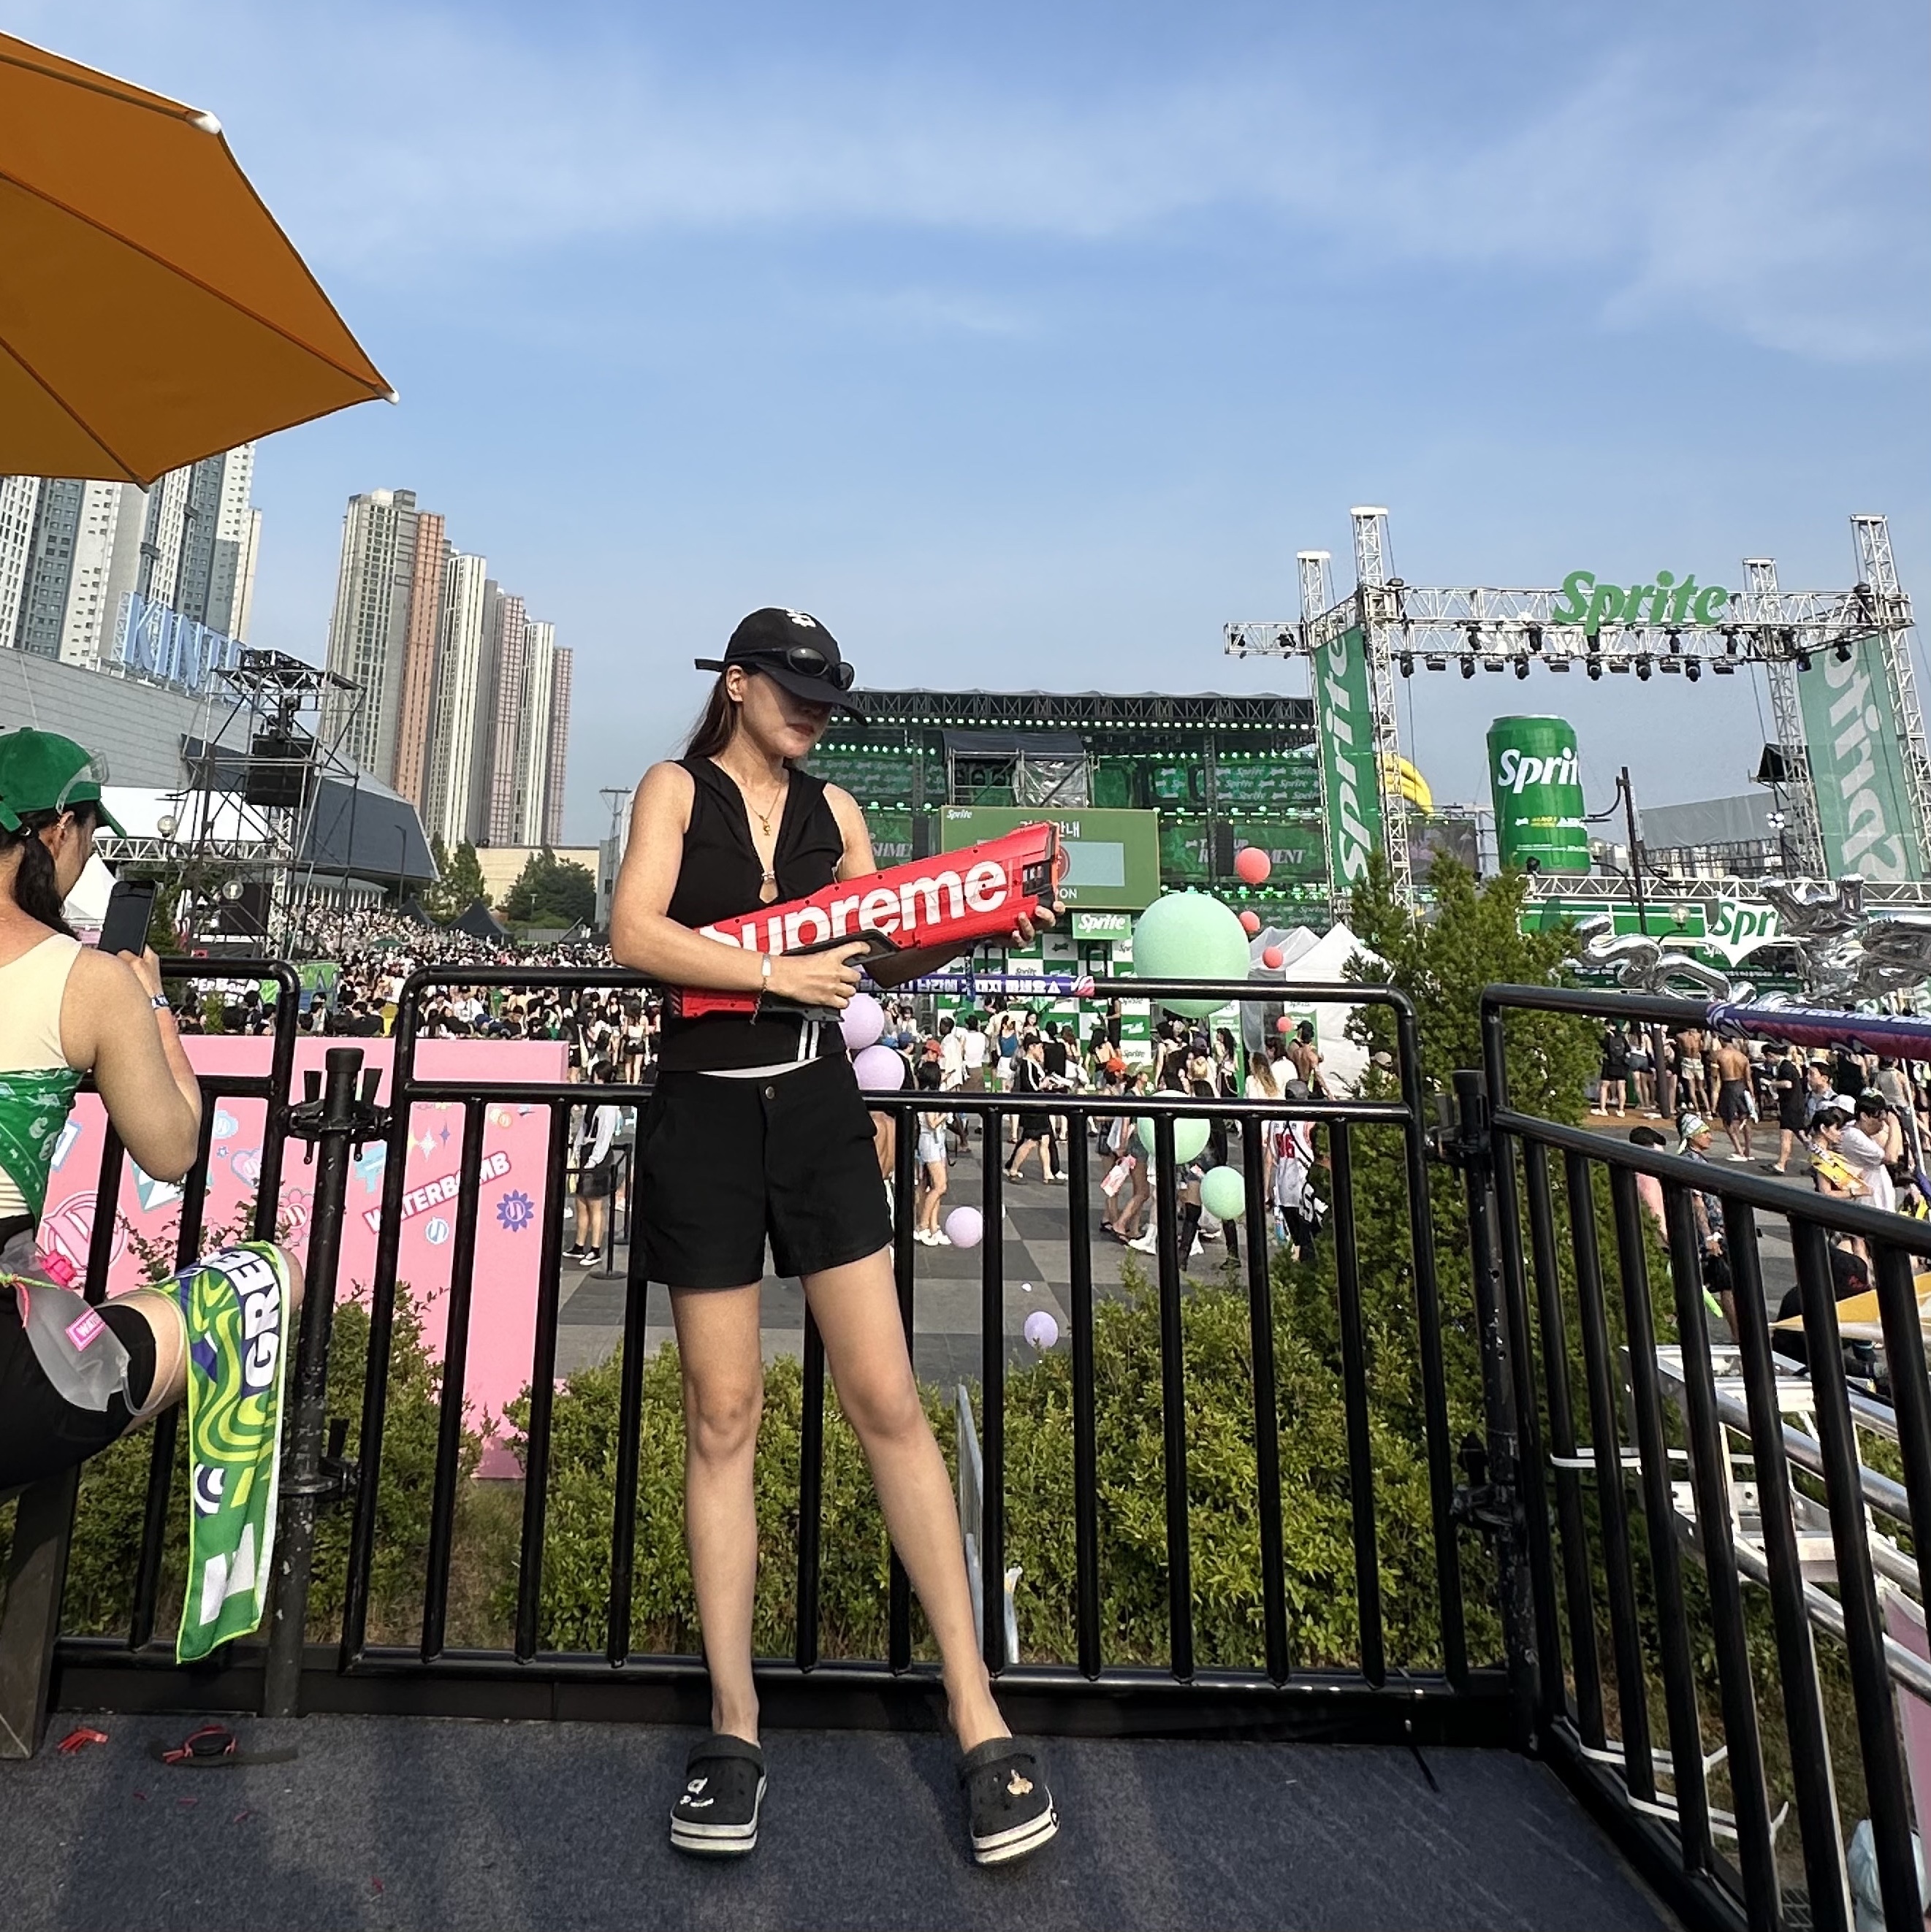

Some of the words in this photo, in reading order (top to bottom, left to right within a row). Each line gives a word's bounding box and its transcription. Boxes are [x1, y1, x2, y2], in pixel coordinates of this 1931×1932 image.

[1553, 570, 1728, 635] Sprite
[1324, 635, 1372, 884] Sprite
[946, 809, 972, 820] Sprite
[1078, 914, 1126, 933] Sprite
